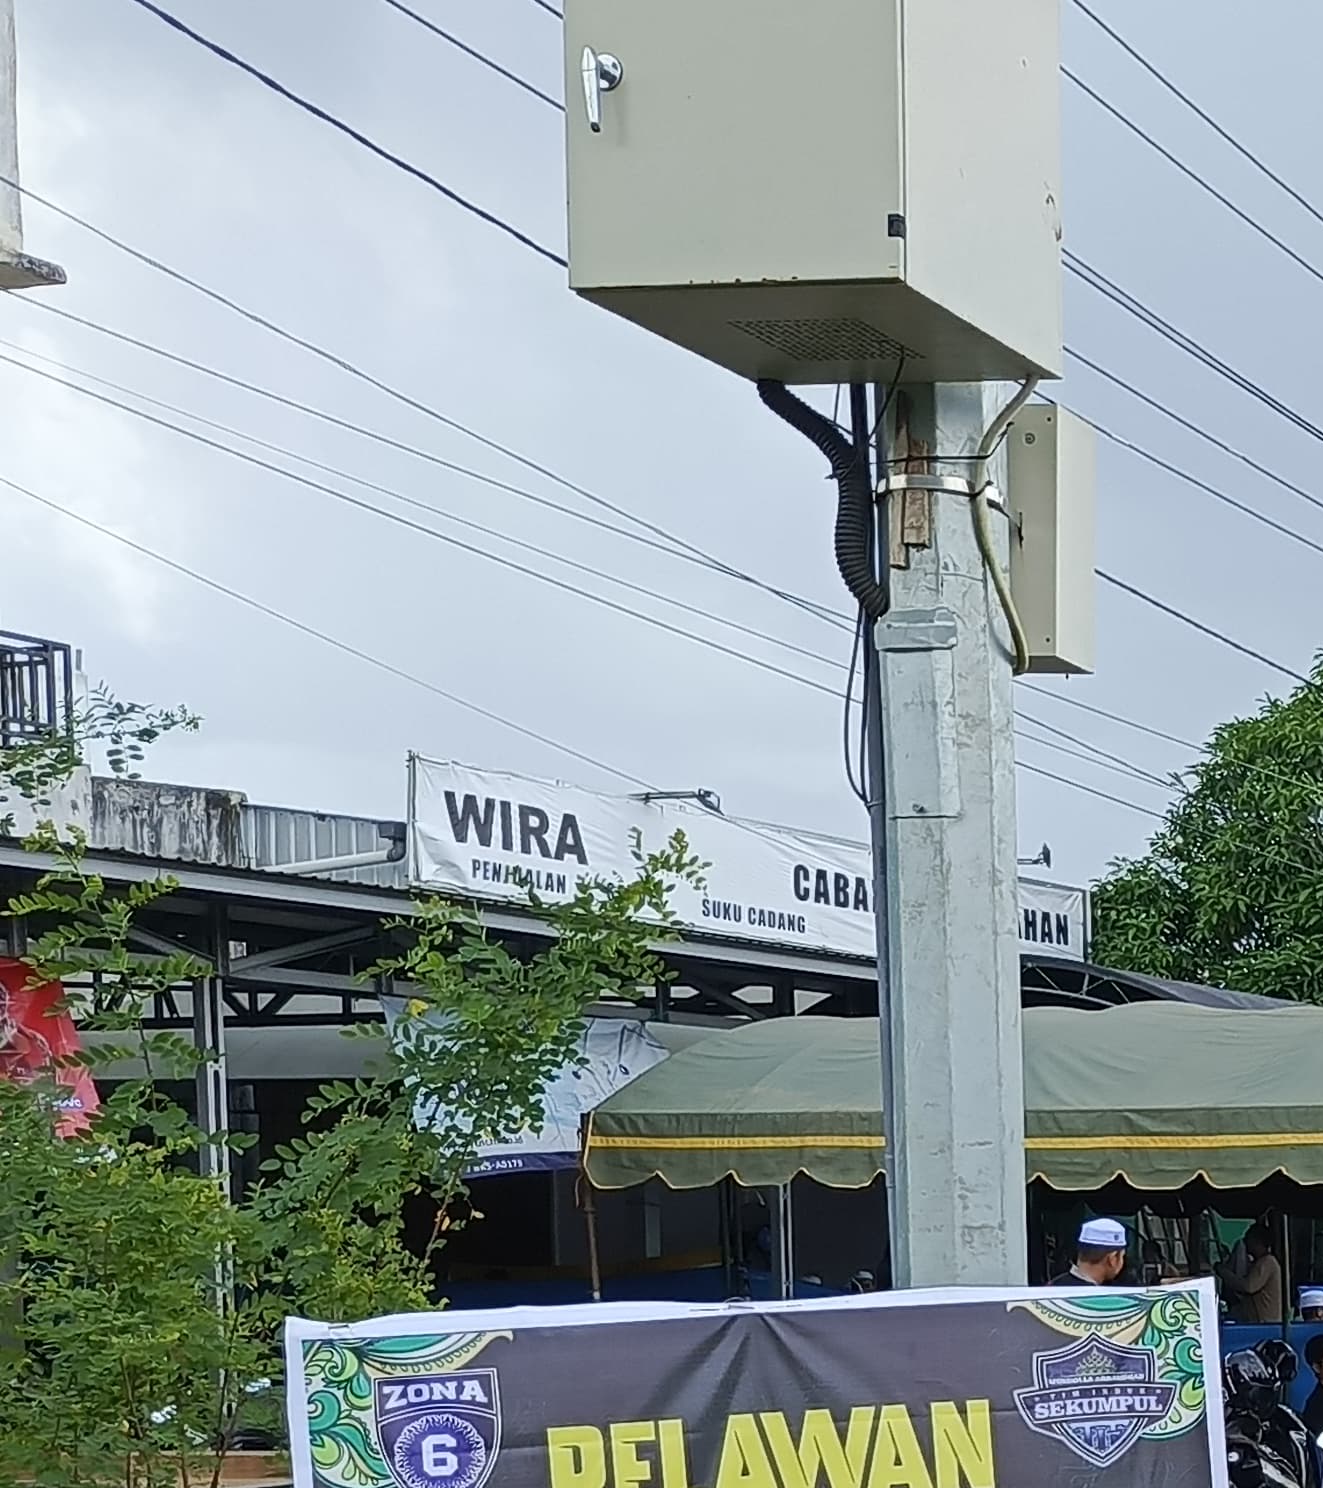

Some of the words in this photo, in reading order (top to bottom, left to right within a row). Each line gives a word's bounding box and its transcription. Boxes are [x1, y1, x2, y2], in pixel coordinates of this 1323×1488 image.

[443, 790, 589, 865] WIRA
[793, 864, 870, 913] CABA
[702, 898, 742, 923] SUKU
[747, 906, 806, 934] CADANG
[382, 1380, 488, 1410] ZONA
[1034, 1395, 1163, 1420] SEKUMPUL
[421, 1433, 458, 1477] 6
